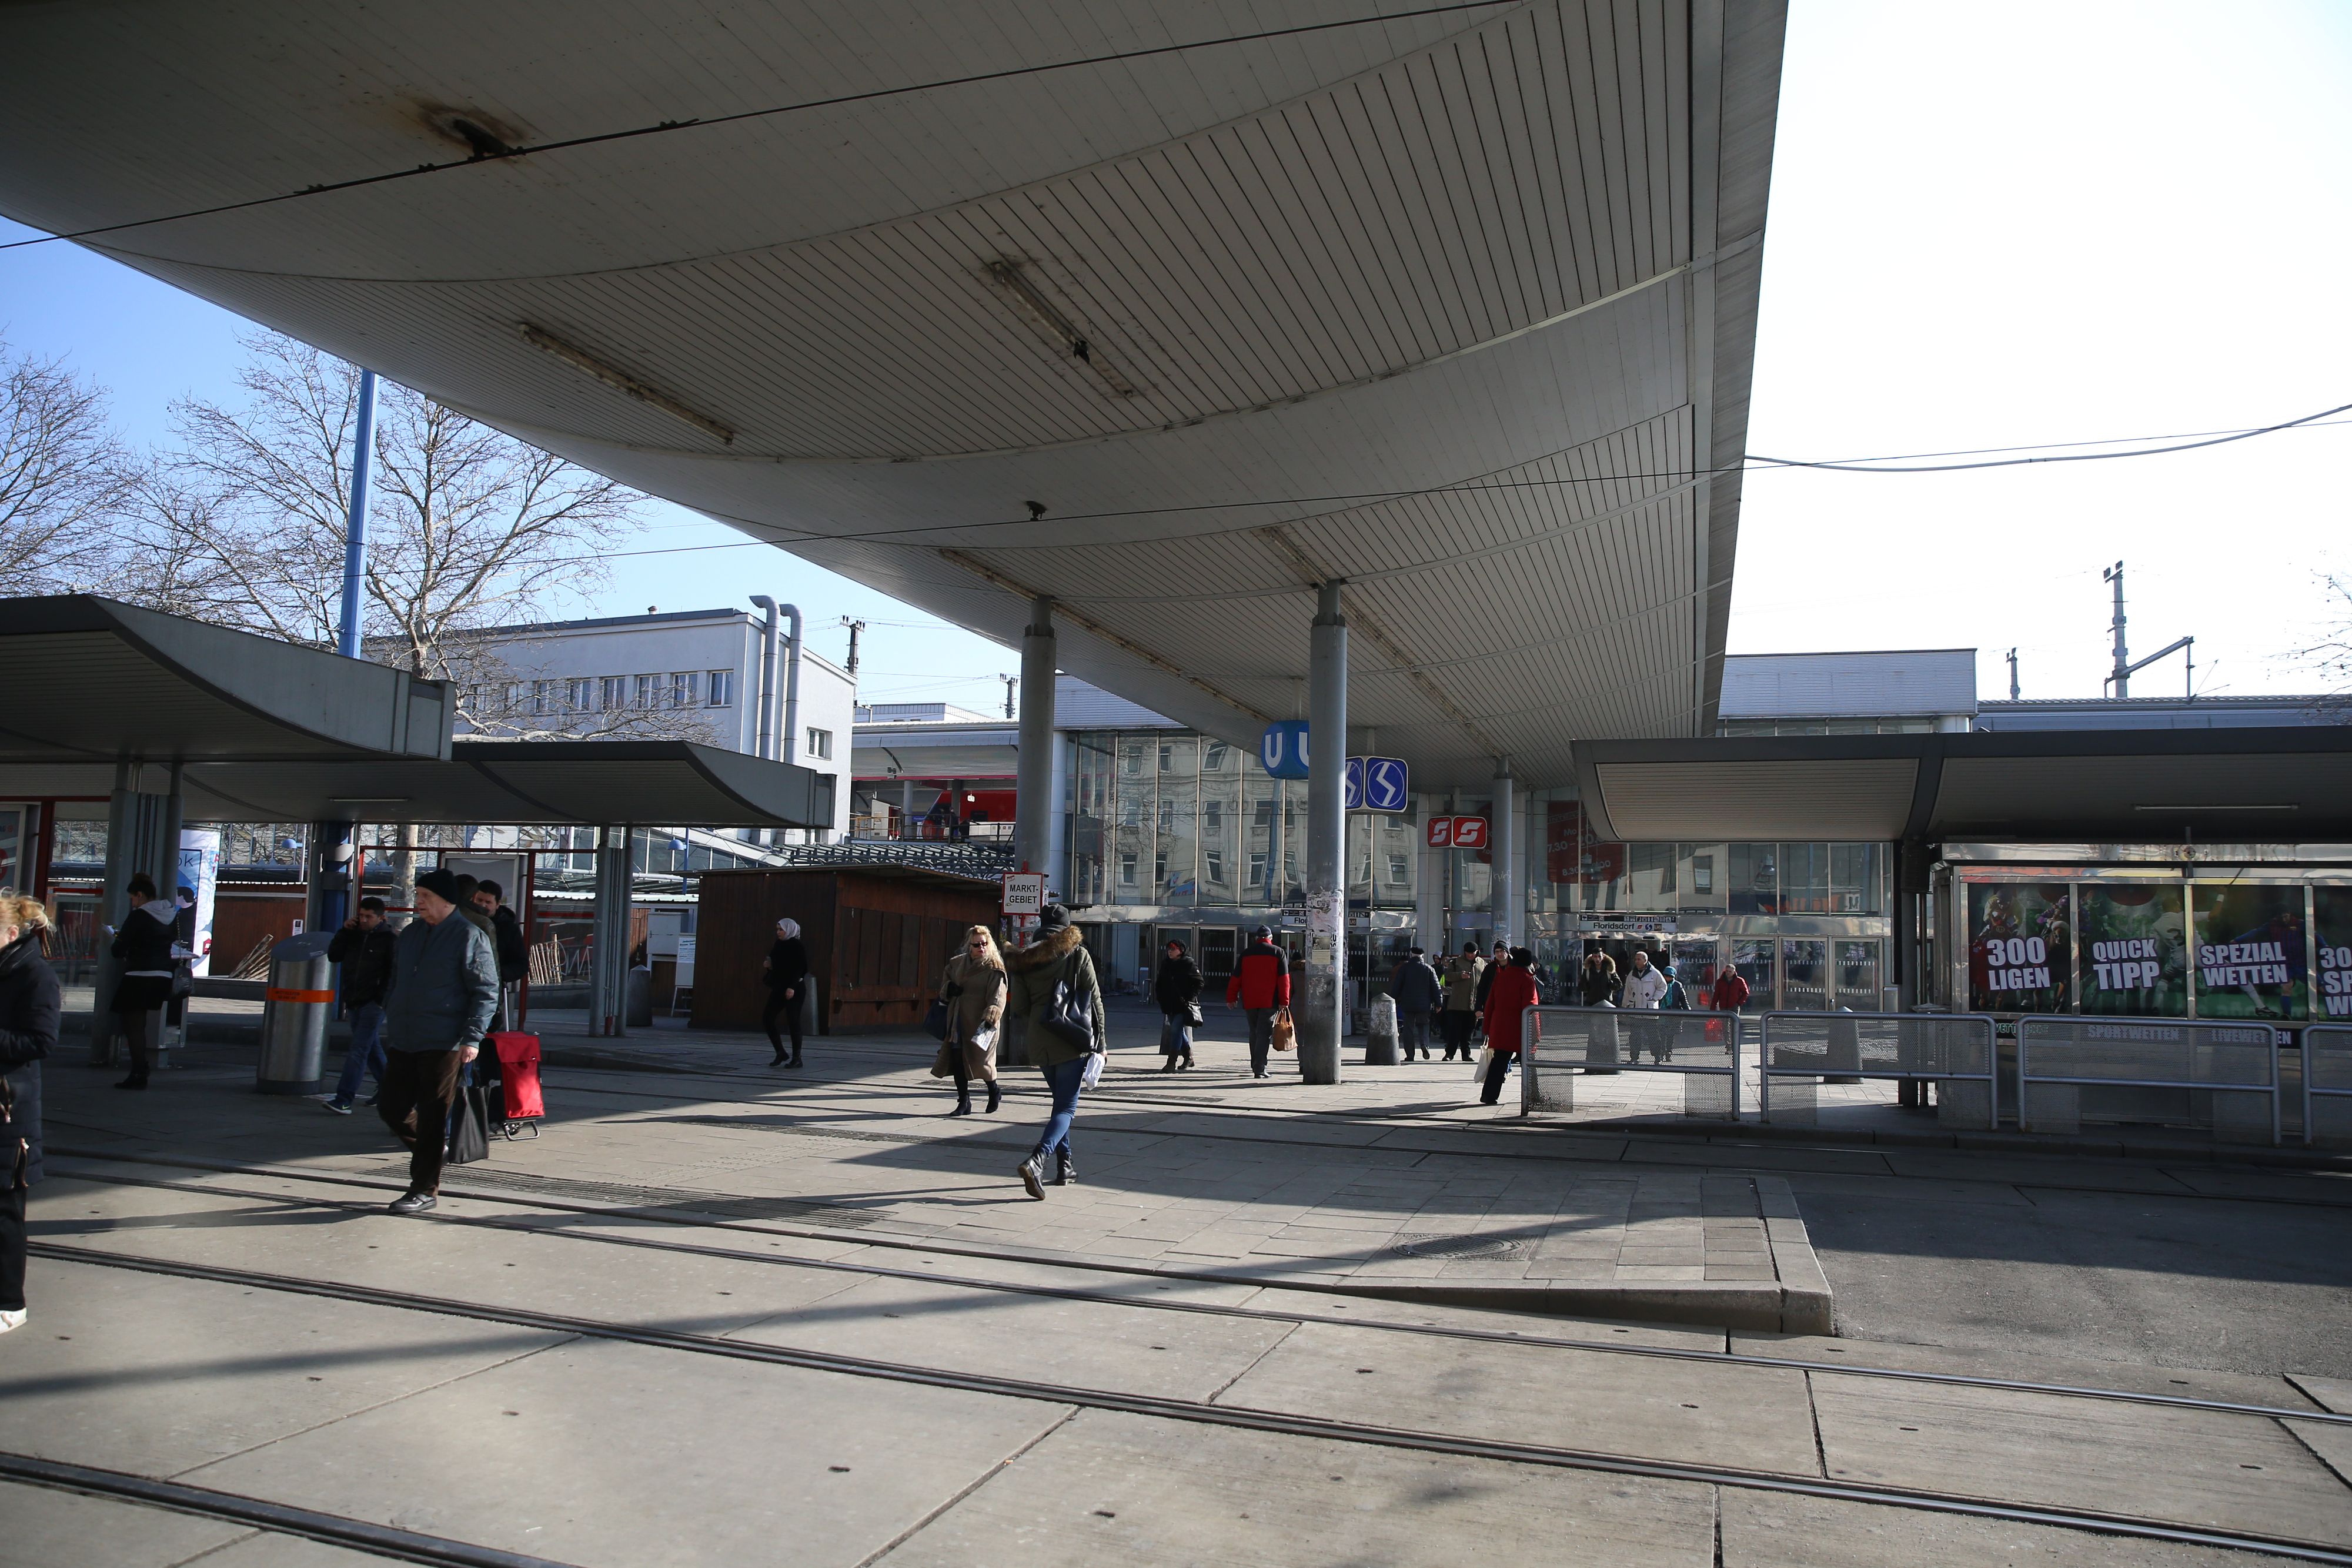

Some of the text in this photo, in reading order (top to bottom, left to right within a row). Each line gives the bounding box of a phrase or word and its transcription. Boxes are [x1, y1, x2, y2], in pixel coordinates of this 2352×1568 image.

[1265, 732, 1282, 768] U
[1009, 895, 1037, 904] GEBIET
[1010, 884, 1038, 892] MARKT-
[1986, 937, 2046, 966] 300
[2093, 939, 2157, 961] QUICK
[2201, 942, 2286, 965] SPEZIAL
[1989, 967, 2051, 990] LIGEN
[2093, 961, 2160, 989] TIPP
[2203, 964, 2288, 986] WETTEN
